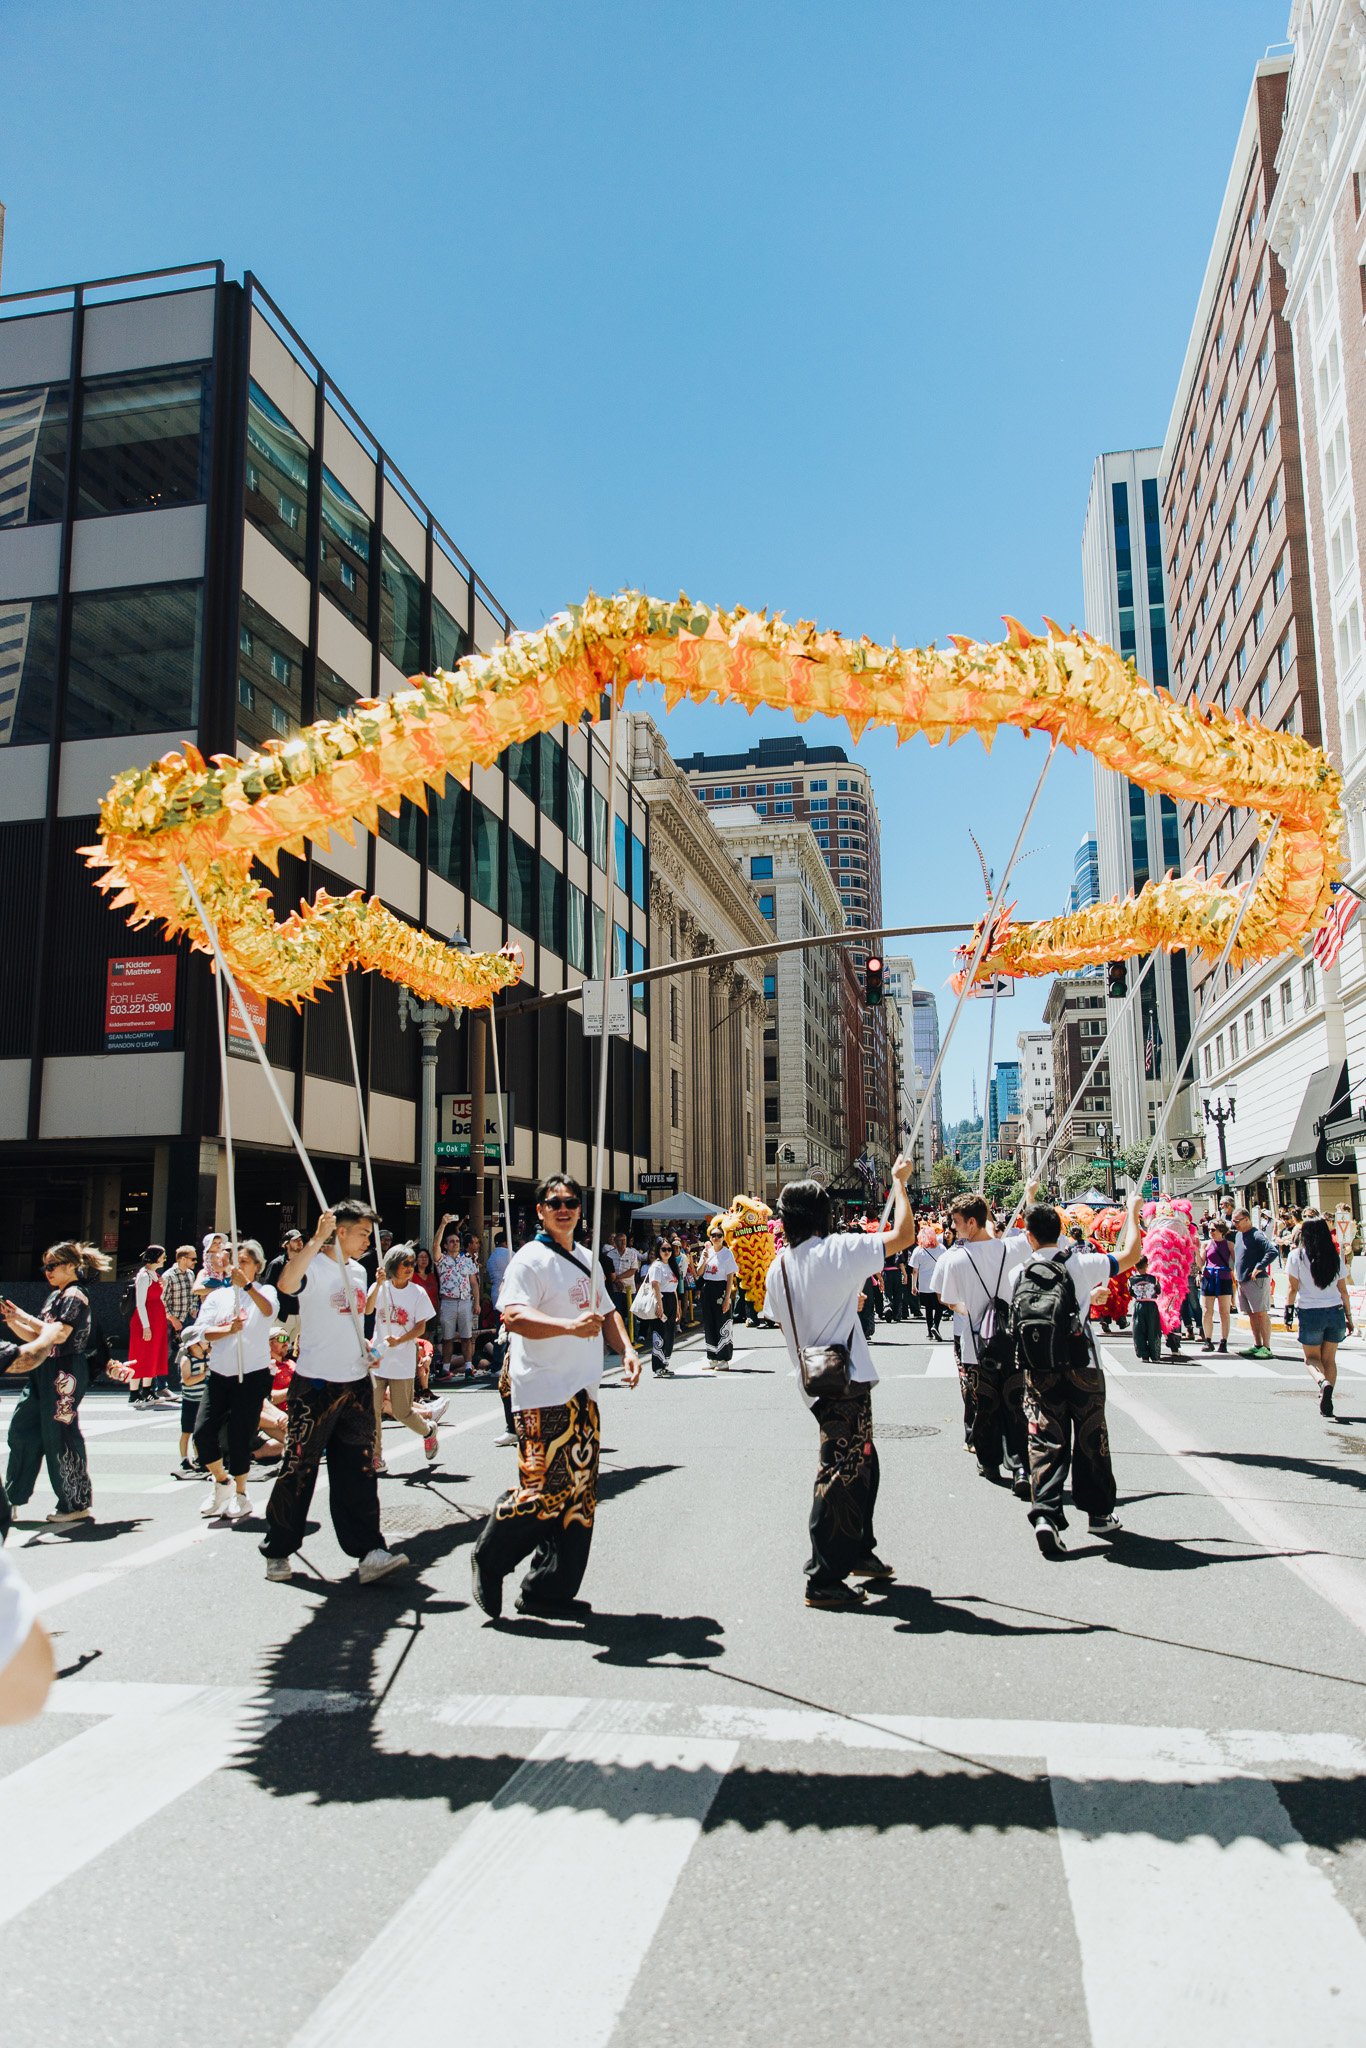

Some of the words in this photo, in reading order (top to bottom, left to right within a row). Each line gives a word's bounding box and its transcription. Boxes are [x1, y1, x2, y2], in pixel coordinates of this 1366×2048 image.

[125, 968, 161, 976] Mathews
[110, 994, 128, 1004] FOR
[131, 993, 159, 1003] LEASE
[110, 1002, 171, 1015] 503.221.9900
[109, 1020, 155, 1028] kiddermathews.com
[452, 1119, 497, 1134] bak
[446, 1145, 459, 1153] Oak
[1296, 1160, 1312, 1172] BENSON
[641, 1174, 665, 1183] COFFEE
[282, 1205, 294, 1213] PAY
[284, 1214, 291, 1222] TO
